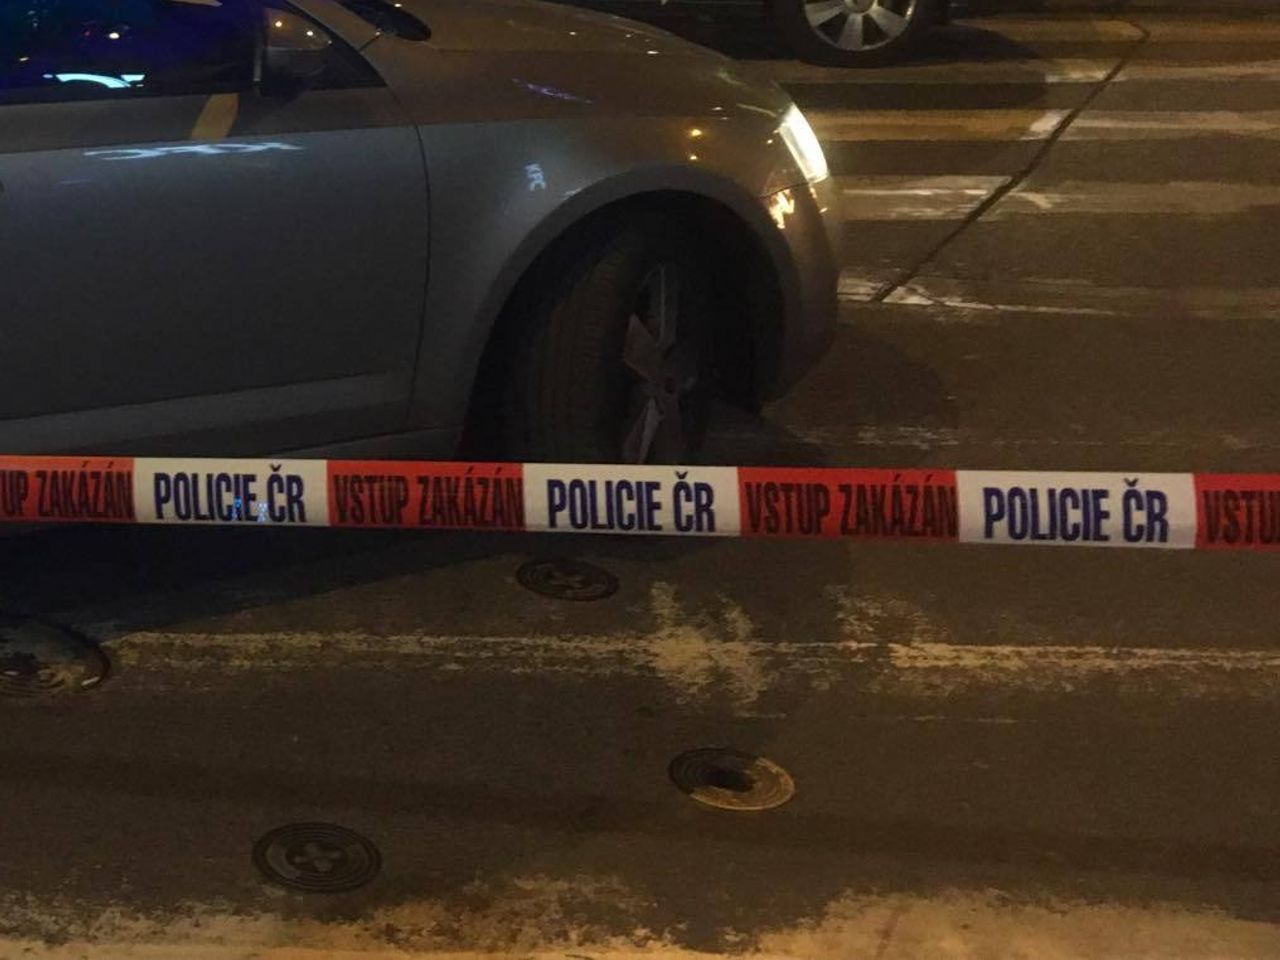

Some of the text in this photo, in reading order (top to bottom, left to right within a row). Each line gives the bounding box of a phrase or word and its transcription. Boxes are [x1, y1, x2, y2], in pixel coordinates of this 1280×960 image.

[35, 460, 135, 520] ZAKÁZÁN
[153, 464, 306, 522] POLICIE ČR
[333, 466, 525, 528] VSTUP ZAKÁZÁN
[547, 471, 716, 532] POLICIE ČR
[744, 473, 959, 537] VSTUP ZAKÁZÁN
[983, 478, 1169, 542] POLICIE ČR
[1202, 489, 1280, 544] VSTU
